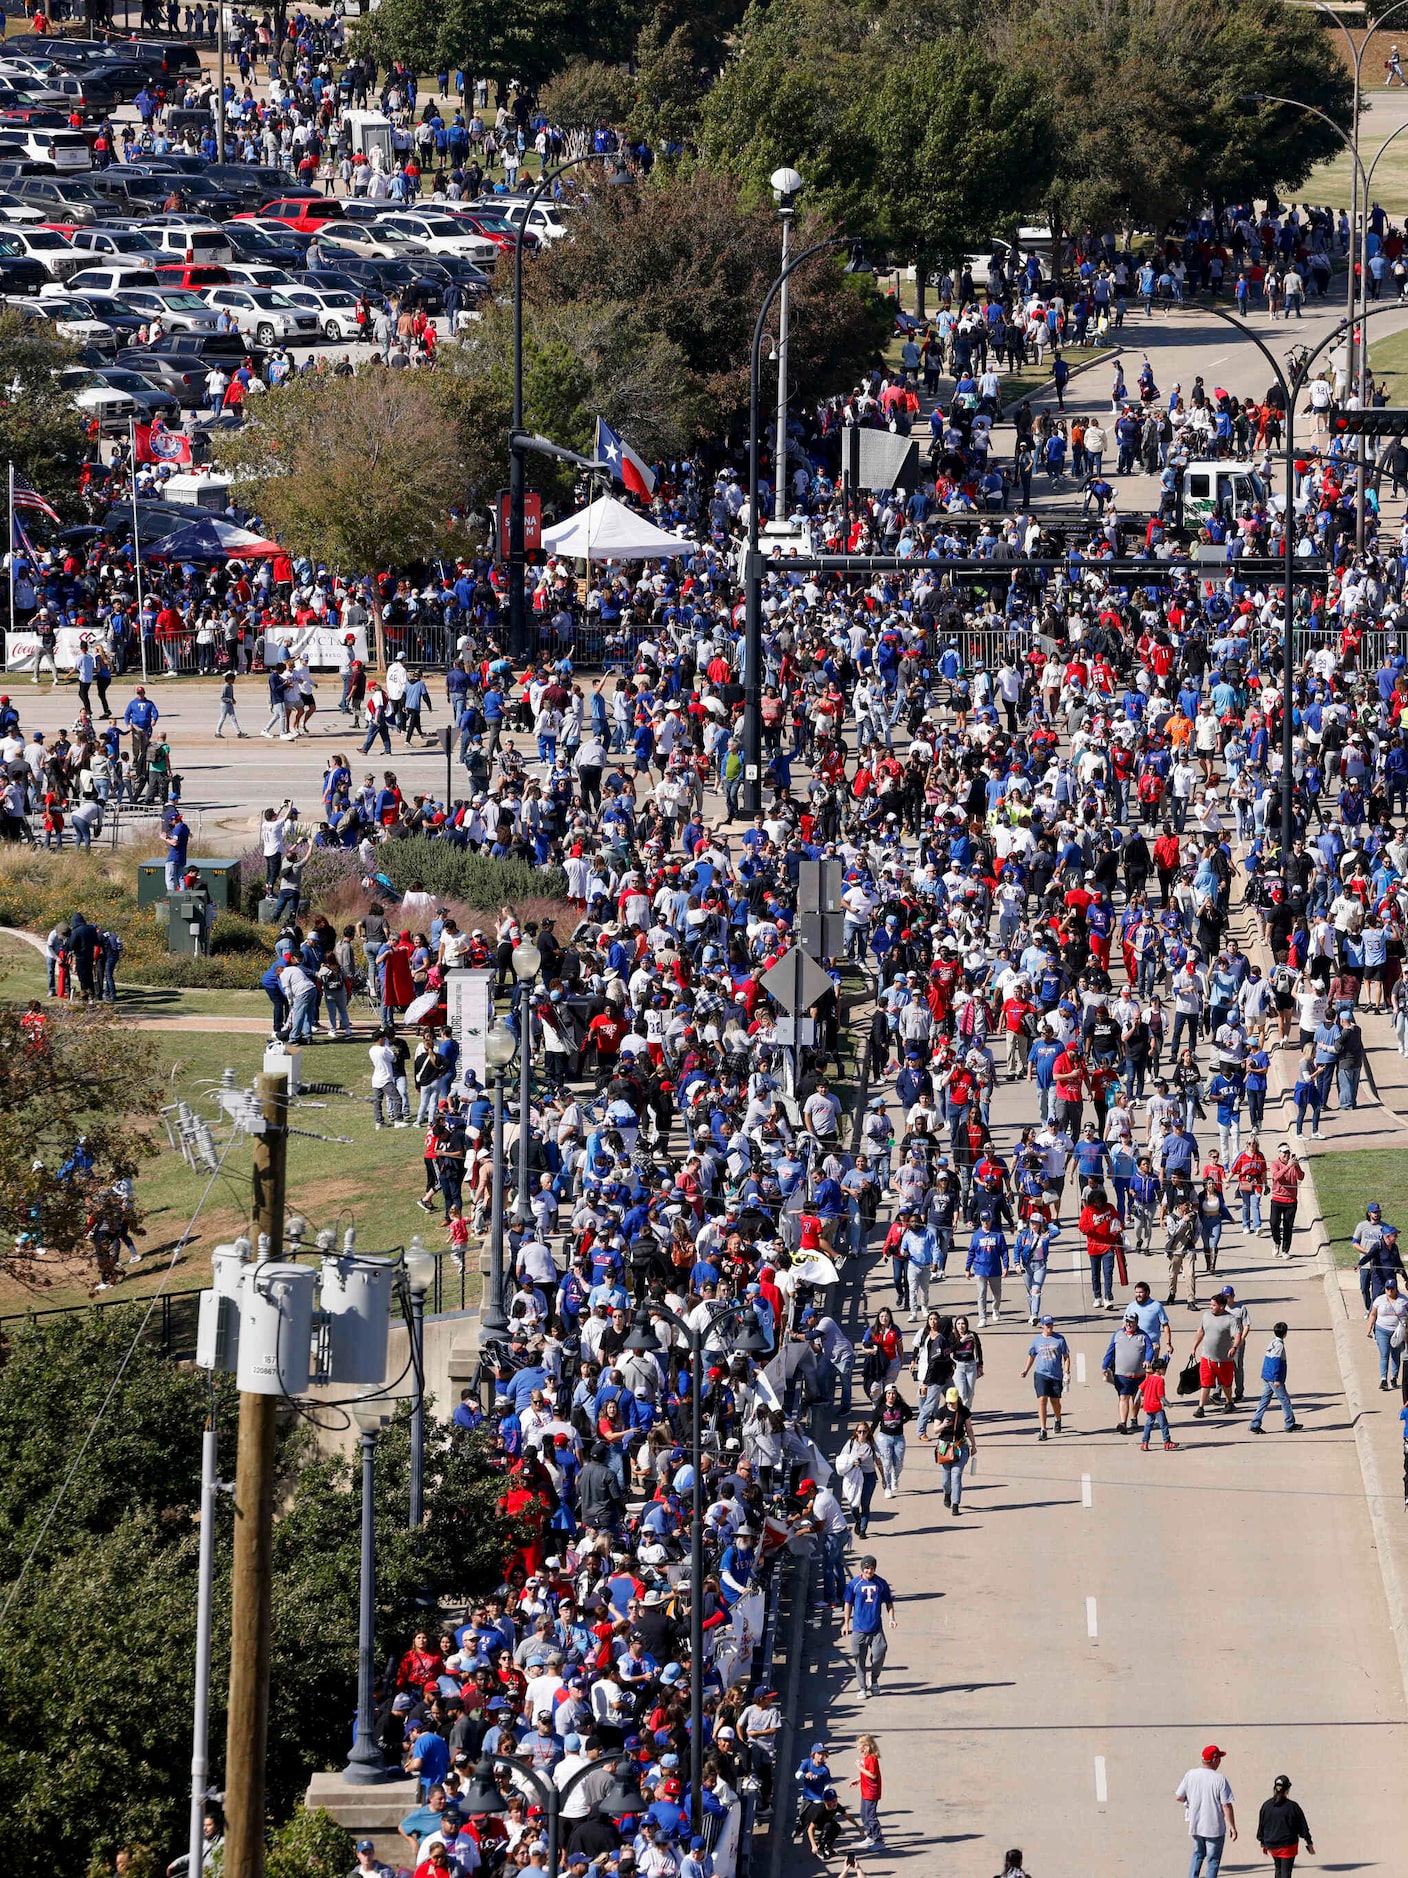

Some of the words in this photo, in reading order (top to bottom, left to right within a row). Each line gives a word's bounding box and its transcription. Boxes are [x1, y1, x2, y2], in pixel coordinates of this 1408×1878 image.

[1093, 674, 1104, 684] 29
[1096, 914, 1104, 922] T
[1367, 940, 1380, 952] 53
[804, 1222, 810, 1232] 7
[862, 1585, 877, 1604] T
